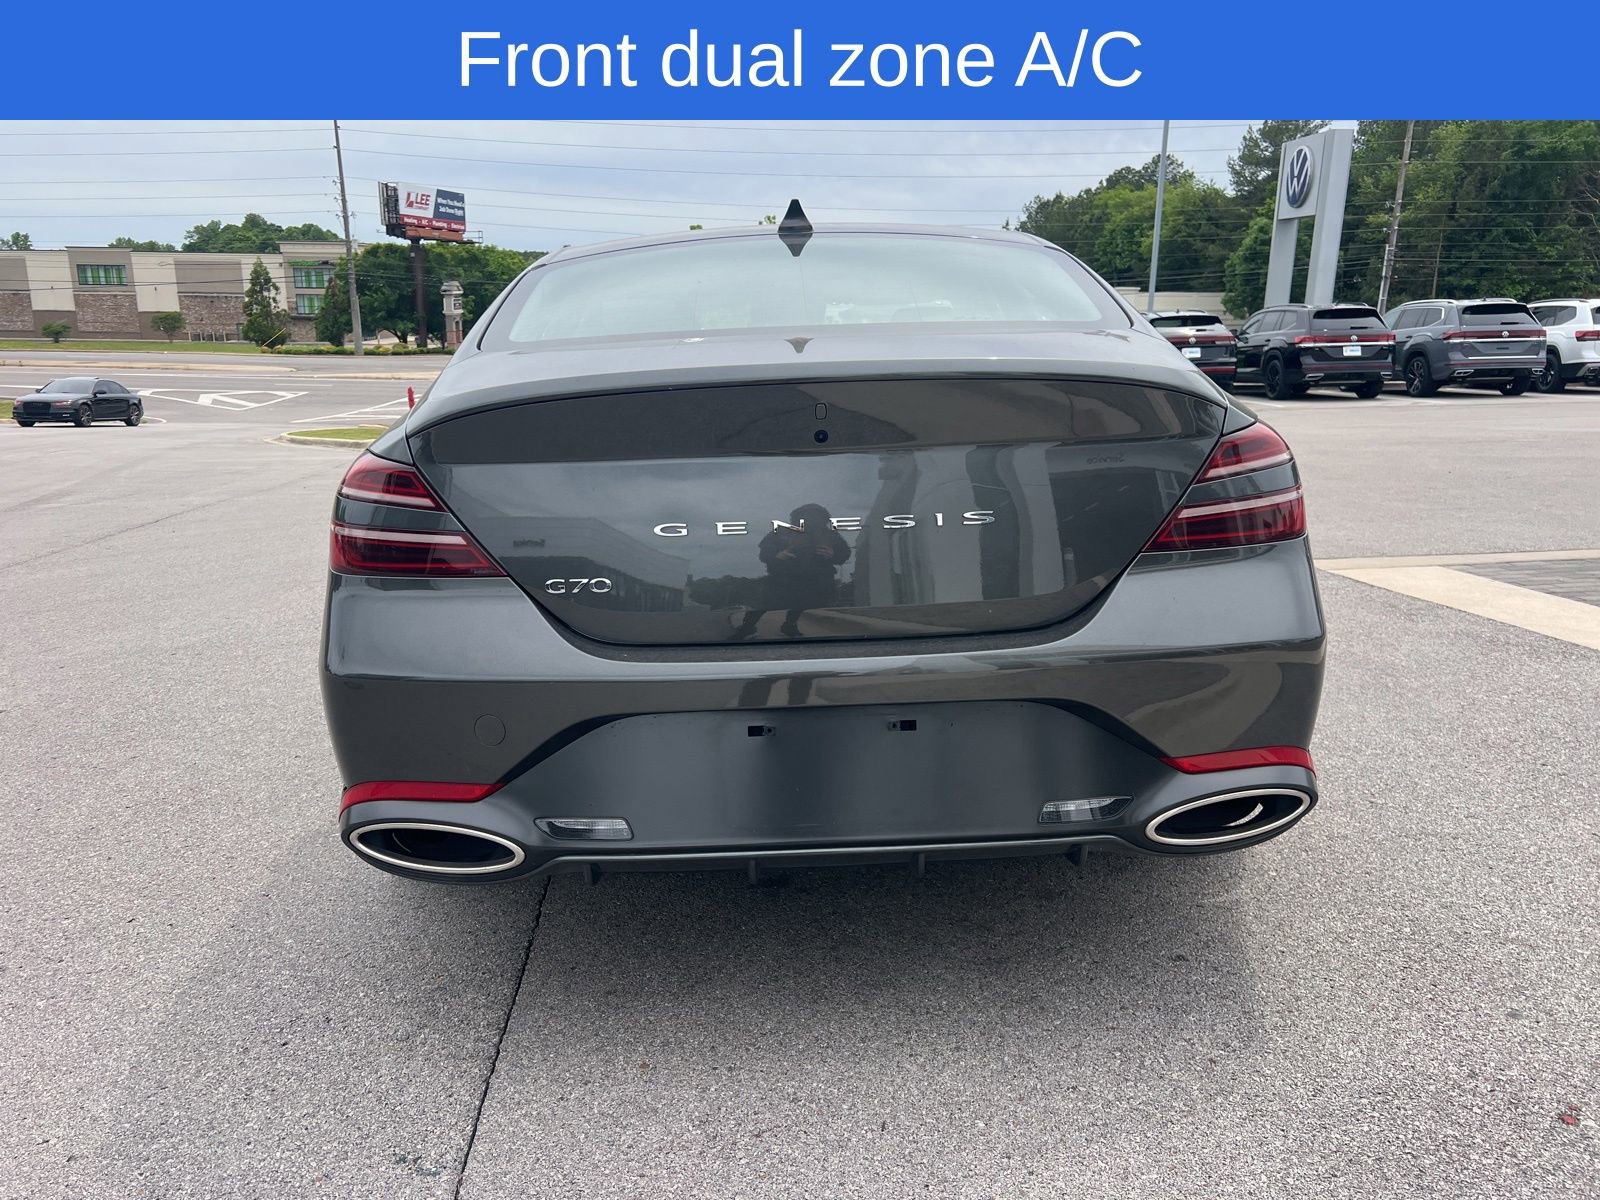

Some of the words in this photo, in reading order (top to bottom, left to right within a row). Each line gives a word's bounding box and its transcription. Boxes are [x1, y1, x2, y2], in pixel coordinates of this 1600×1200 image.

[415, 192, 431, 206] LEE
[653, 509, 996, 538] GENESIS
[544, 577, 612, 594] G70
